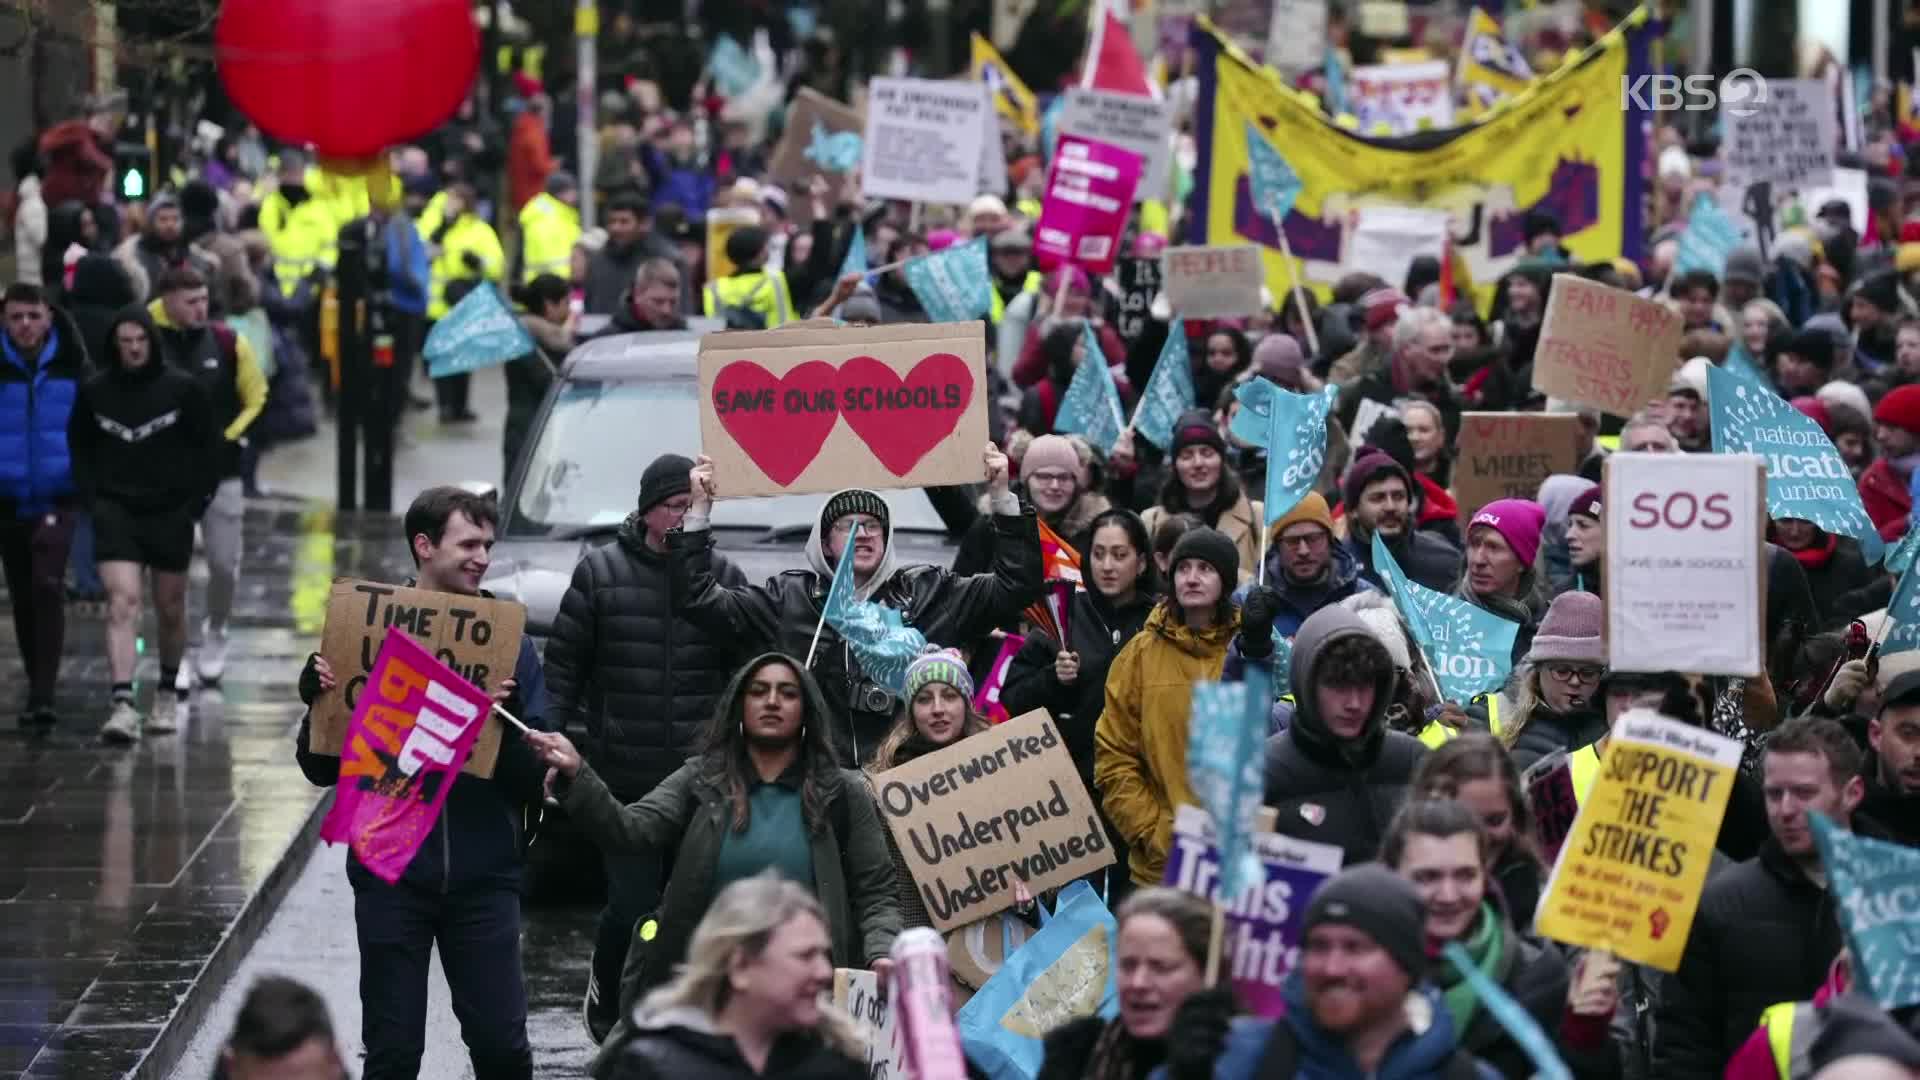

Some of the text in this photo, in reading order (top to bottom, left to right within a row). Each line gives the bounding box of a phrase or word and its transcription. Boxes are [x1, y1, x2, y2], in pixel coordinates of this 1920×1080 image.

[1566, 286, 1619, 316] FAIR
[1544, 337, 1637, 382] TEACHERS
[715, 383, 962, 414] SAVE OUR SCHOOLS
[1629, 490, 1733, 532] SOS
[1778, 481, 1847, 501] union
[355, 583, 492, 646] TIME TO
[881, 721, 1060, 819] Overworked
[1603, 746, 1720, 804] SUPPORT
[907, 779, 1071, 866] Underpaid
[1616, 787, 1668, 831] THE
[922, 815, 1106, 921] Undervalued
[1583, 822, 1689, 879] STRIKES
